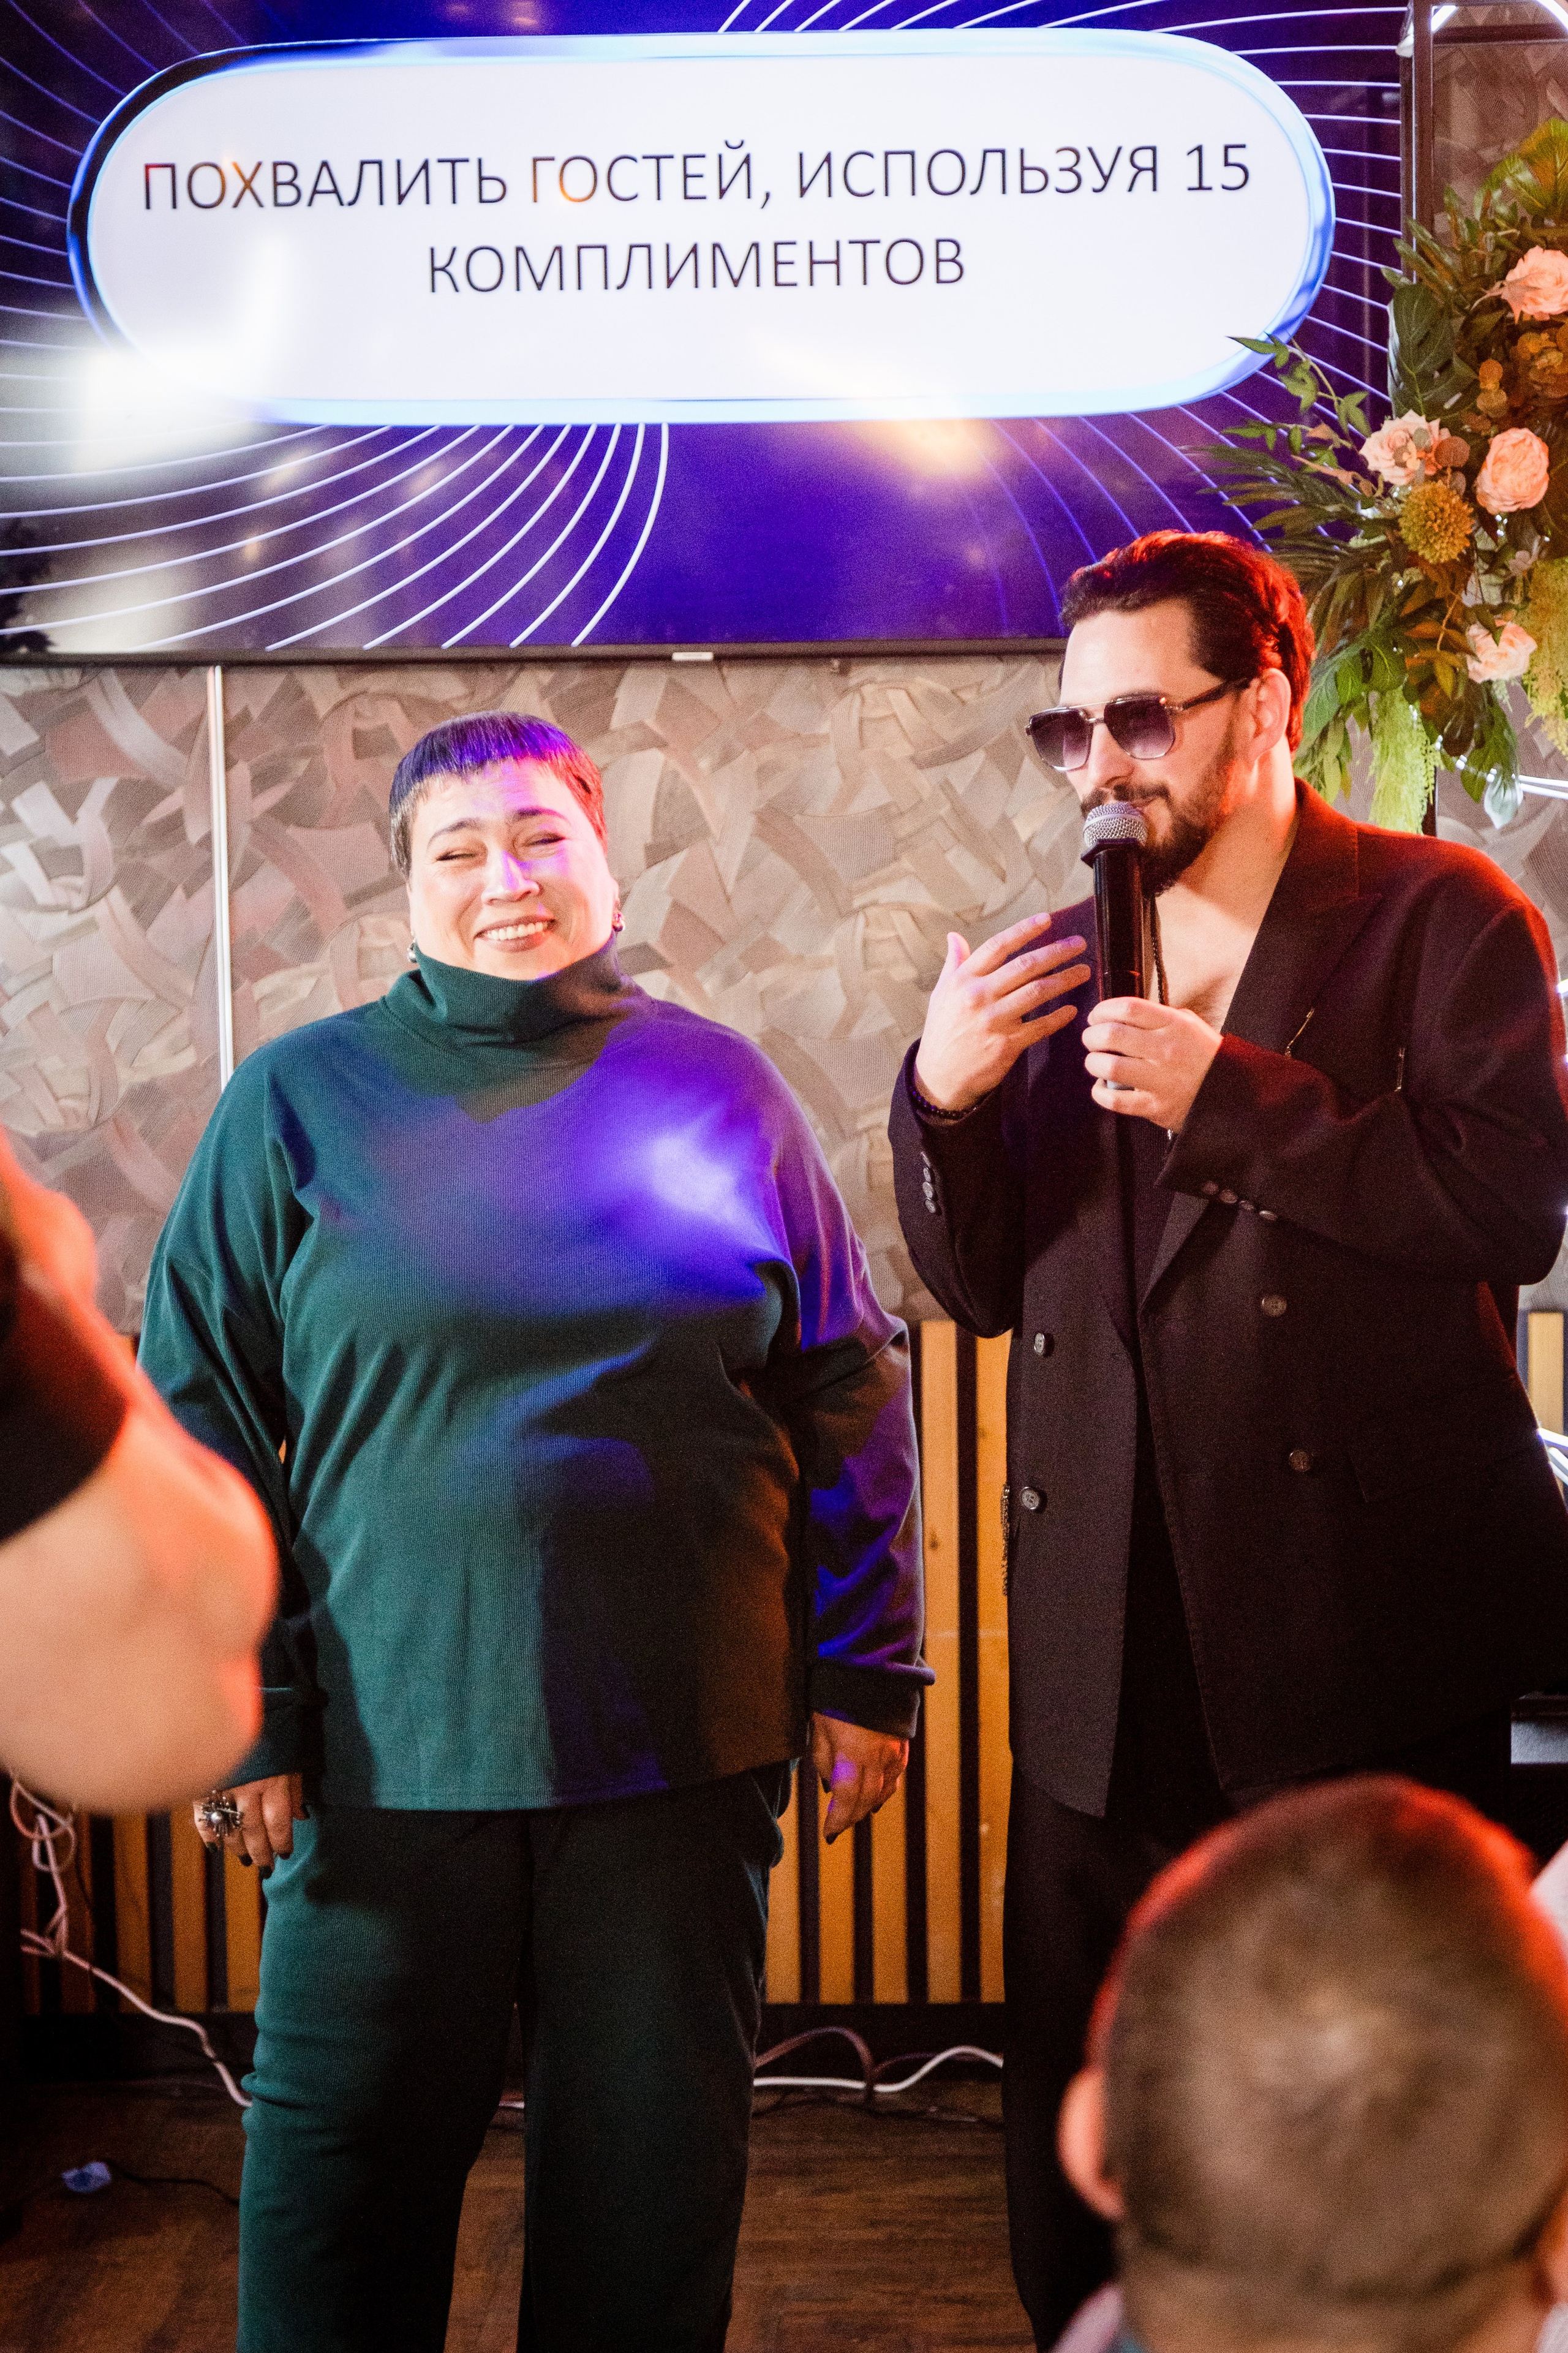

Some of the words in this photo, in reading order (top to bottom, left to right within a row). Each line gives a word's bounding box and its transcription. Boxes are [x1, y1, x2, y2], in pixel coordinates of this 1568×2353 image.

[144, 157, 508, 211] ПОХВАЛИТЬ
[532, 139, 771, 210] ГОСТЕЙ,
[799, 145, 1158, 198] ИСПОЛЬЗУЯ
[1186, 143, 1250, 192] 15
[429, 238, 965, 294] КОМПЛИМЕНТОВ
